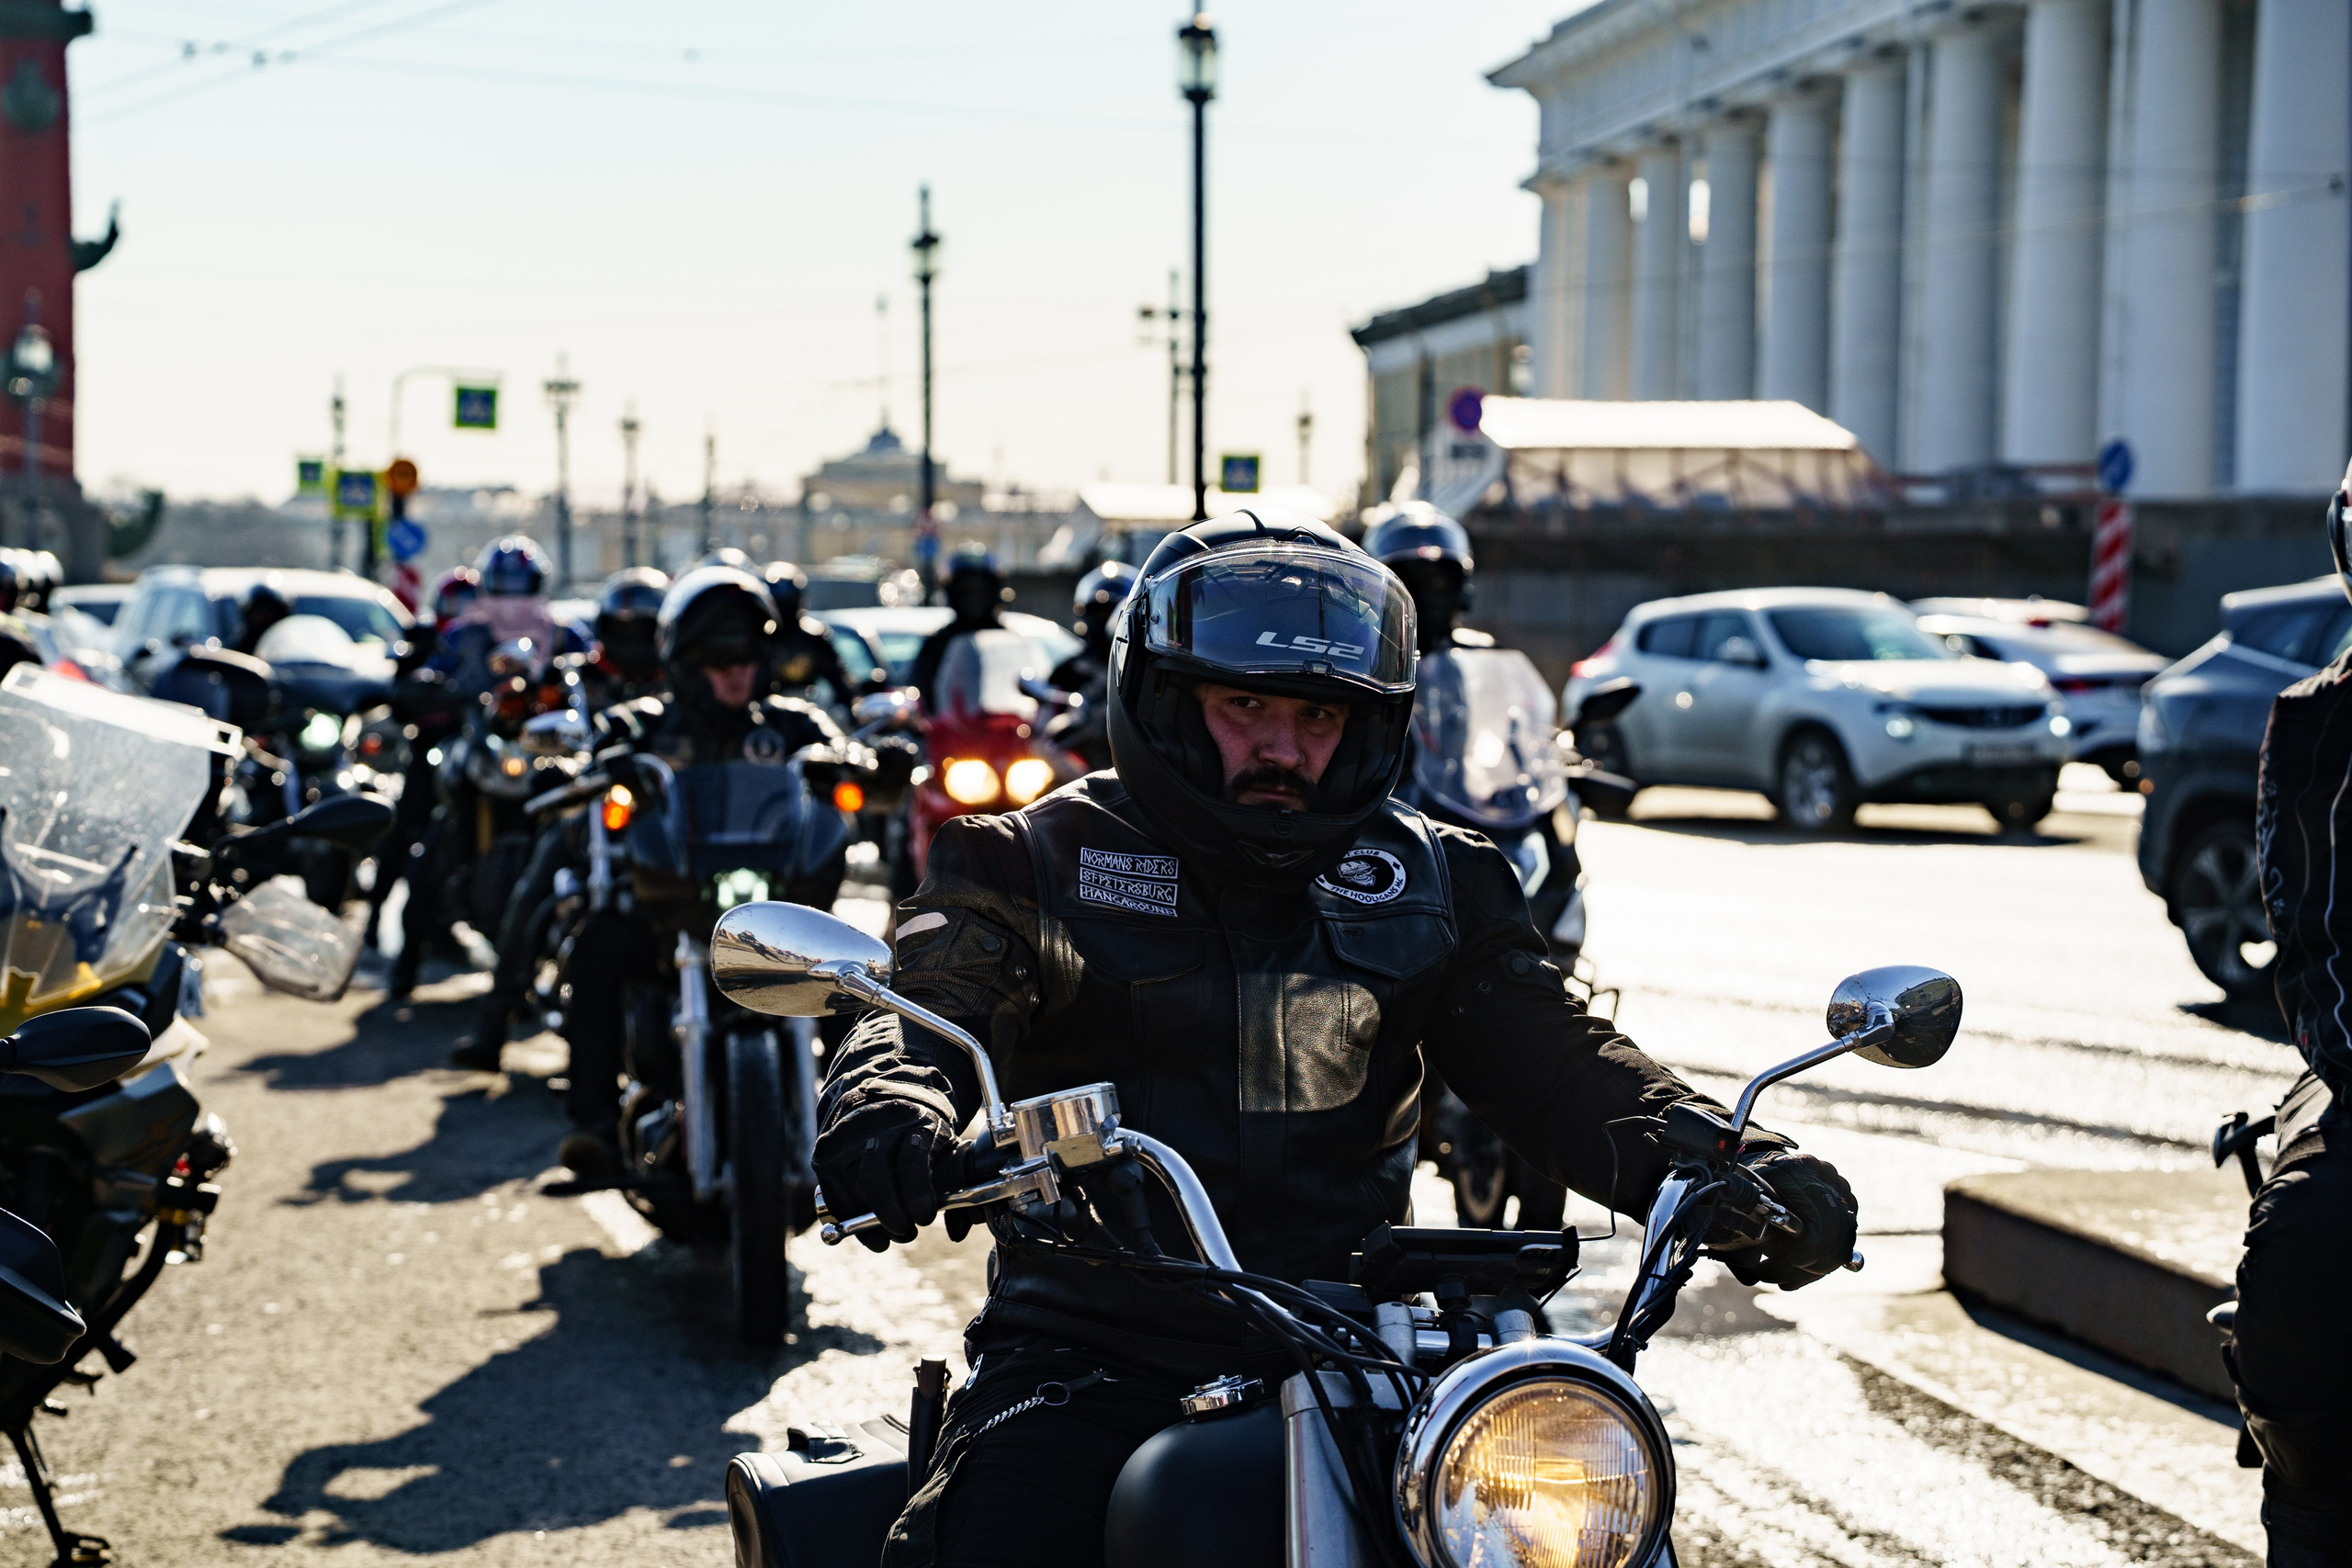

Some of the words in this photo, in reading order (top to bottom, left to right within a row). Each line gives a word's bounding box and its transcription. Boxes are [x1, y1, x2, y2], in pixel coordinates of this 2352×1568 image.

[1255, 631, 1365, 660] LS2
[1083, 850, 1133, 871] NORMANS
[1135, 858, 1175, 874] RIDERS
[1330, 886, 1350, 896] THE
[1350, 886, 1398, 903] HOOLIGANS
[1396, 876, 1404, 889] MC
